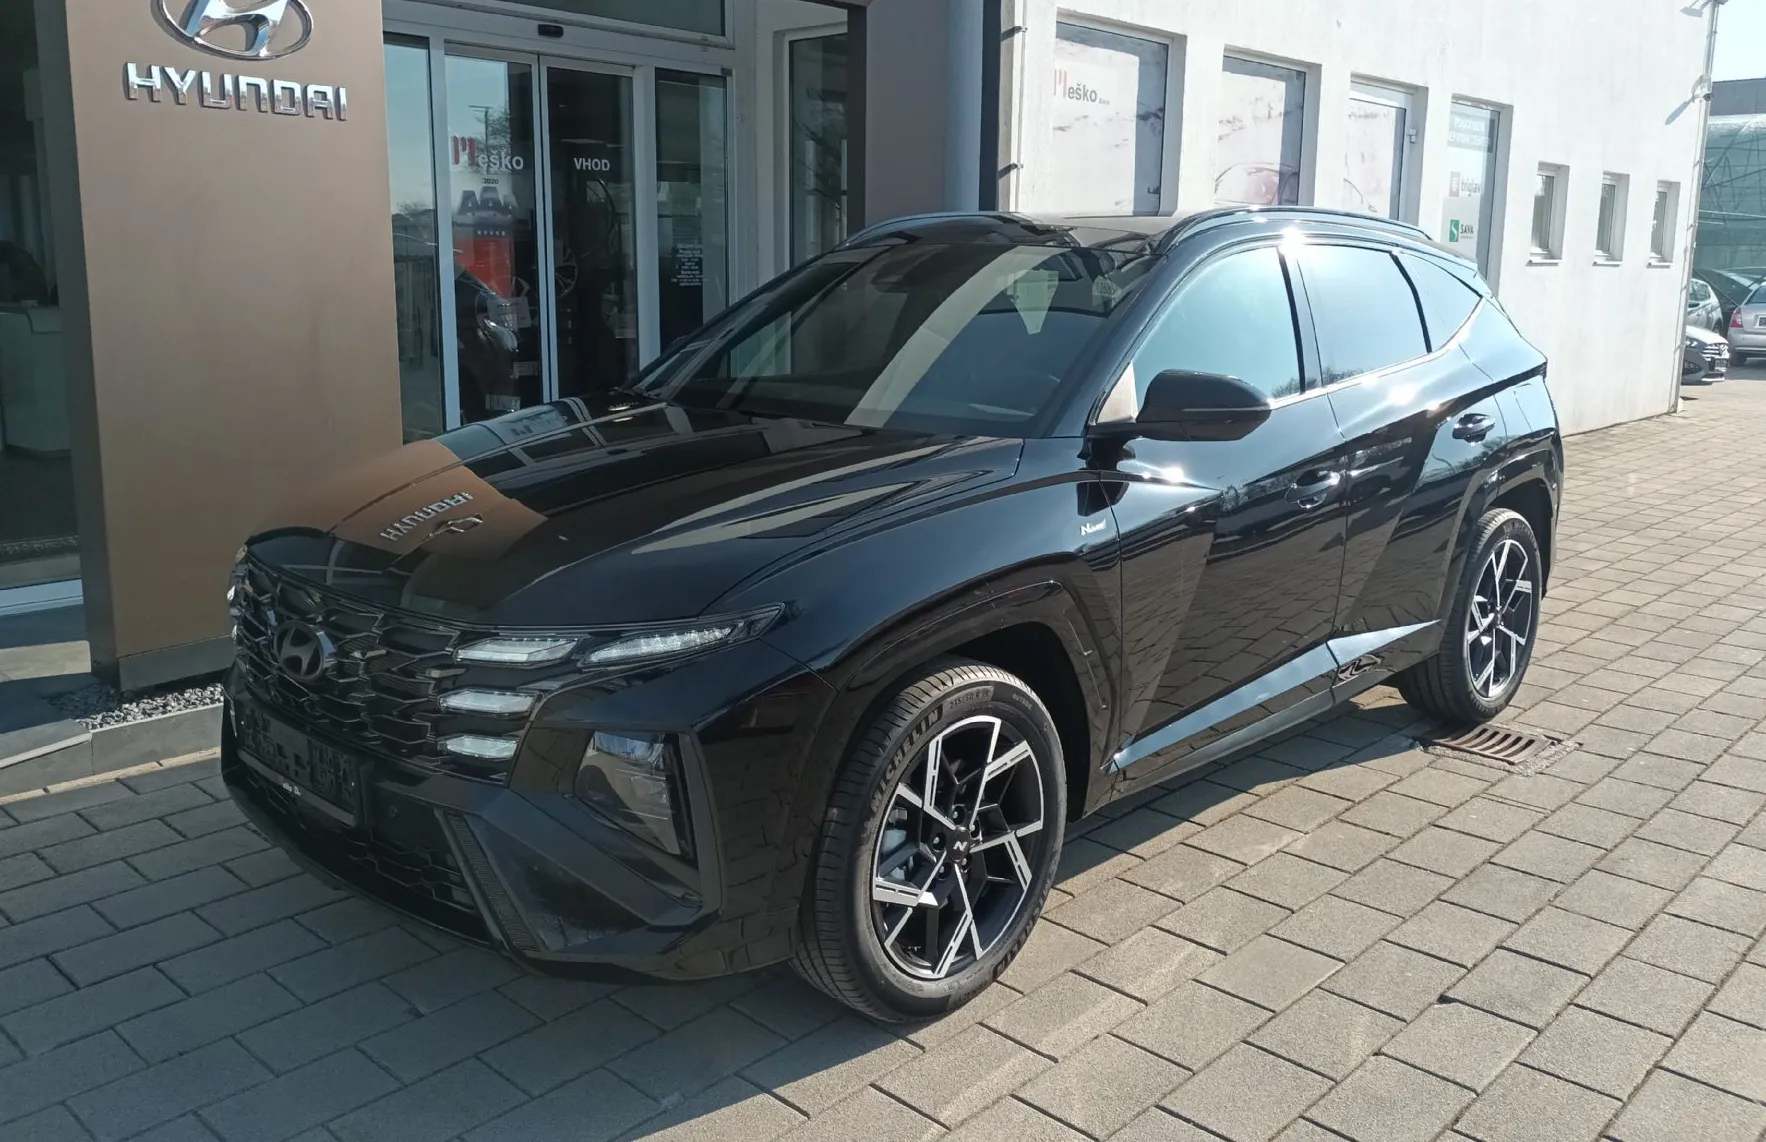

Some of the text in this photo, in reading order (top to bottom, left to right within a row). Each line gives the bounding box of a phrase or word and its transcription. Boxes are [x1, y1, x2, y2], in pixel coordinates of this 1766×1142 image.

[124, 62, 347, 121] HYUNDAI
[573, 157, 611, 171] VHOD
[483, 177, 499, 186] 2020
[1460, 223, 1474, 235] SAVA
[870, 706, 942, 812] MICHELIN
